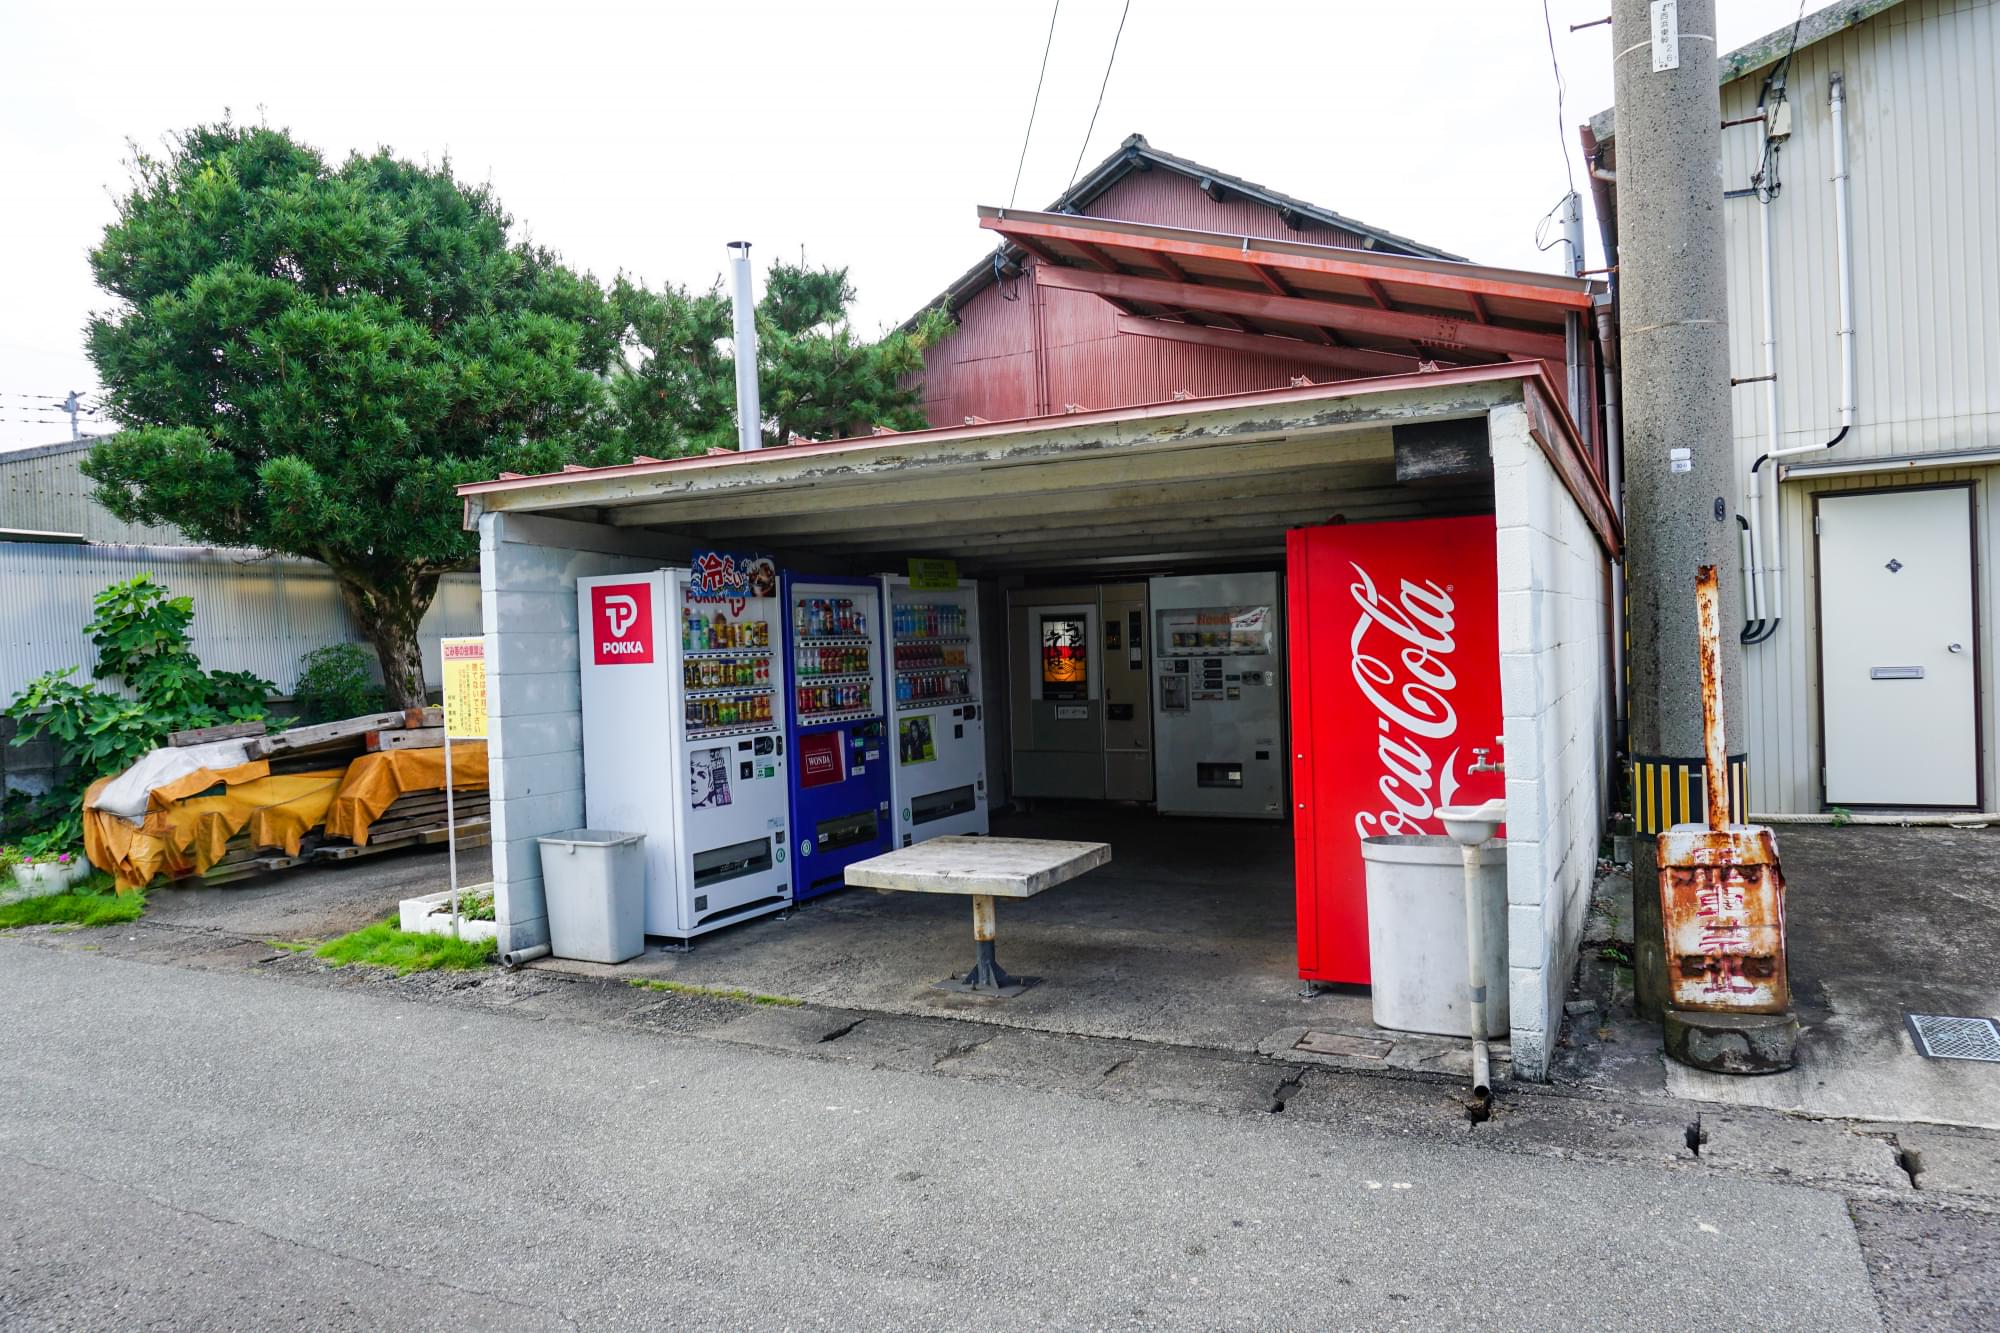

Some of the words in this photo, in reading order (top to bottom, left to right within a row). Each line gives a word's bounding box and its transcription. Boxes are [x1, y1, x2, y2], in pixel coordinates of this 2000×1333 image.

[698, 552, 744, 592] 冷たい
[602, 640, 645, 655] POKKA
[808, 754, 831, 767] WONDA
